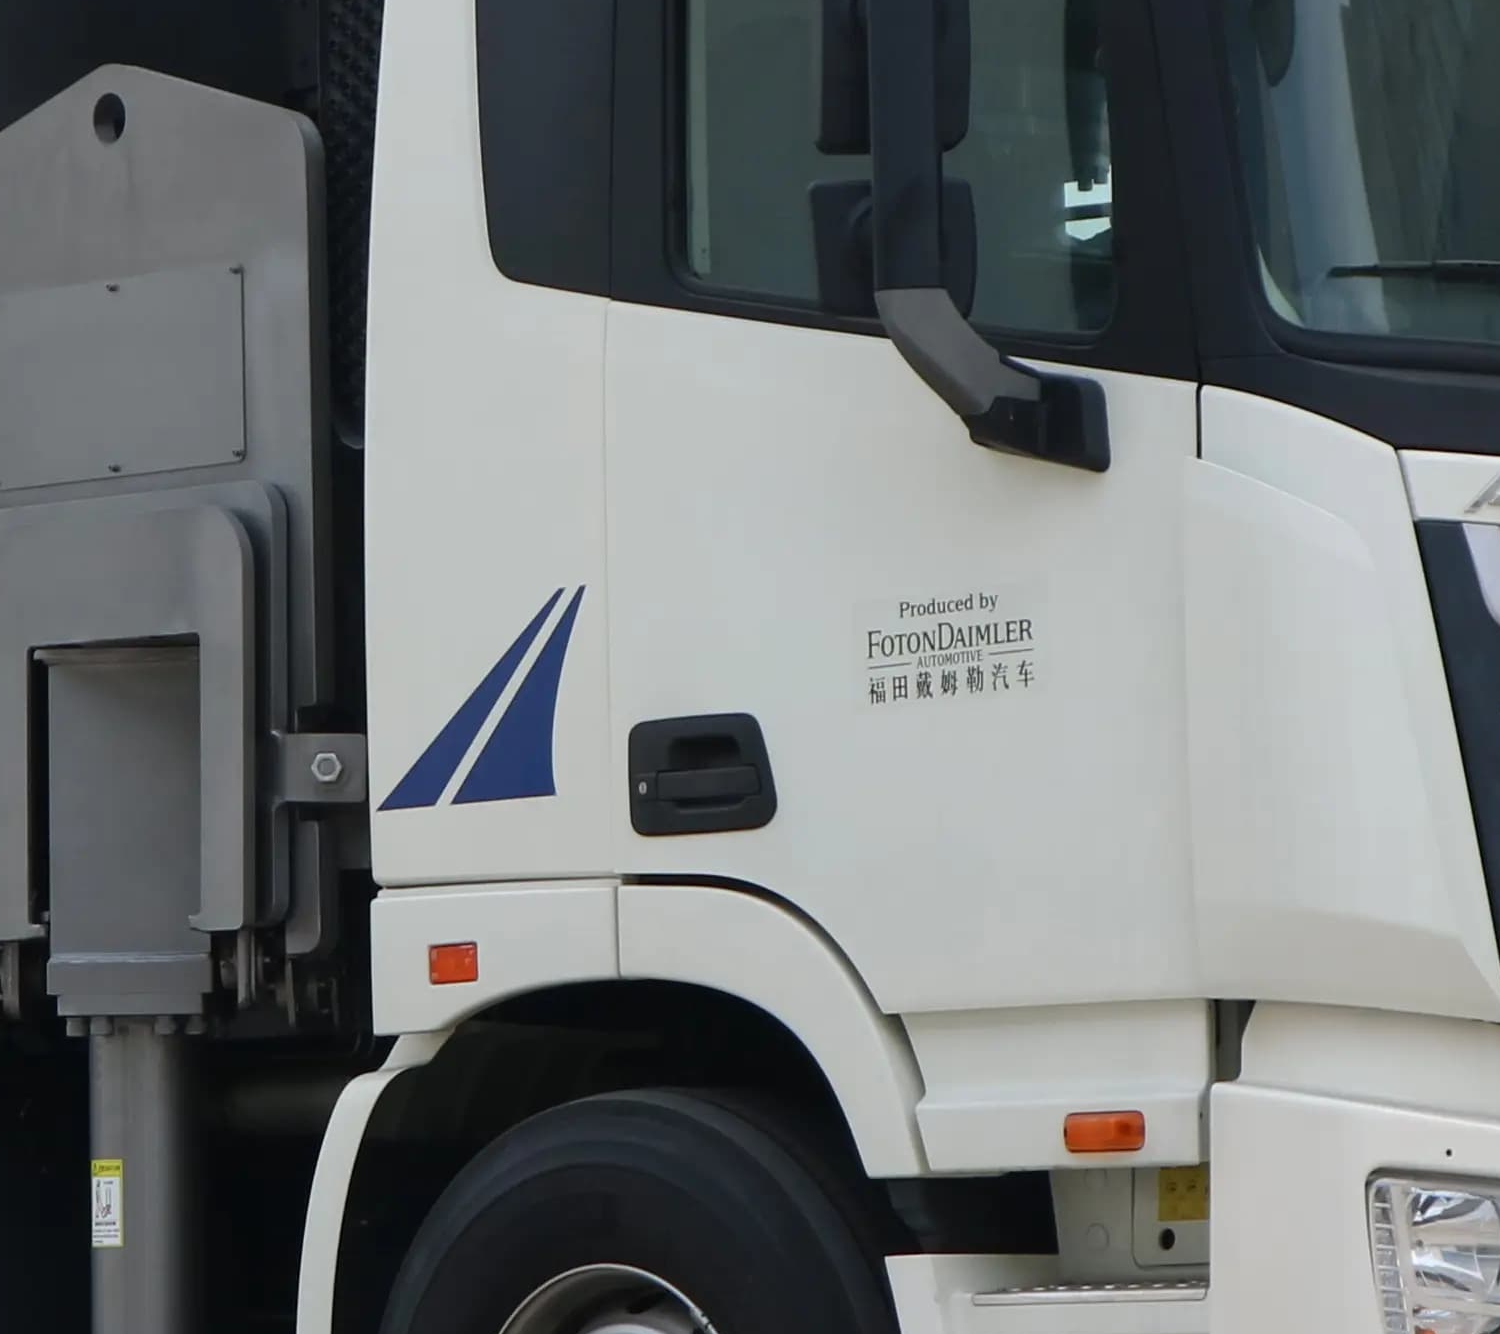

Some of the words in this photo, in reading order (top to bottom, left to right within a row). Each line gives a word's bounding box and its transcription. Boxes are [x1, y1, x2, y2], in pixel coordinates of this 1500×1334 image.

[899, 593, 974, 618] Produced
[979, 592, 999, 612] by
[916, 649, 984, 668] AUTOMOTIVE
[868, 659, 1035, 705] 福田戴姆勒汽车
